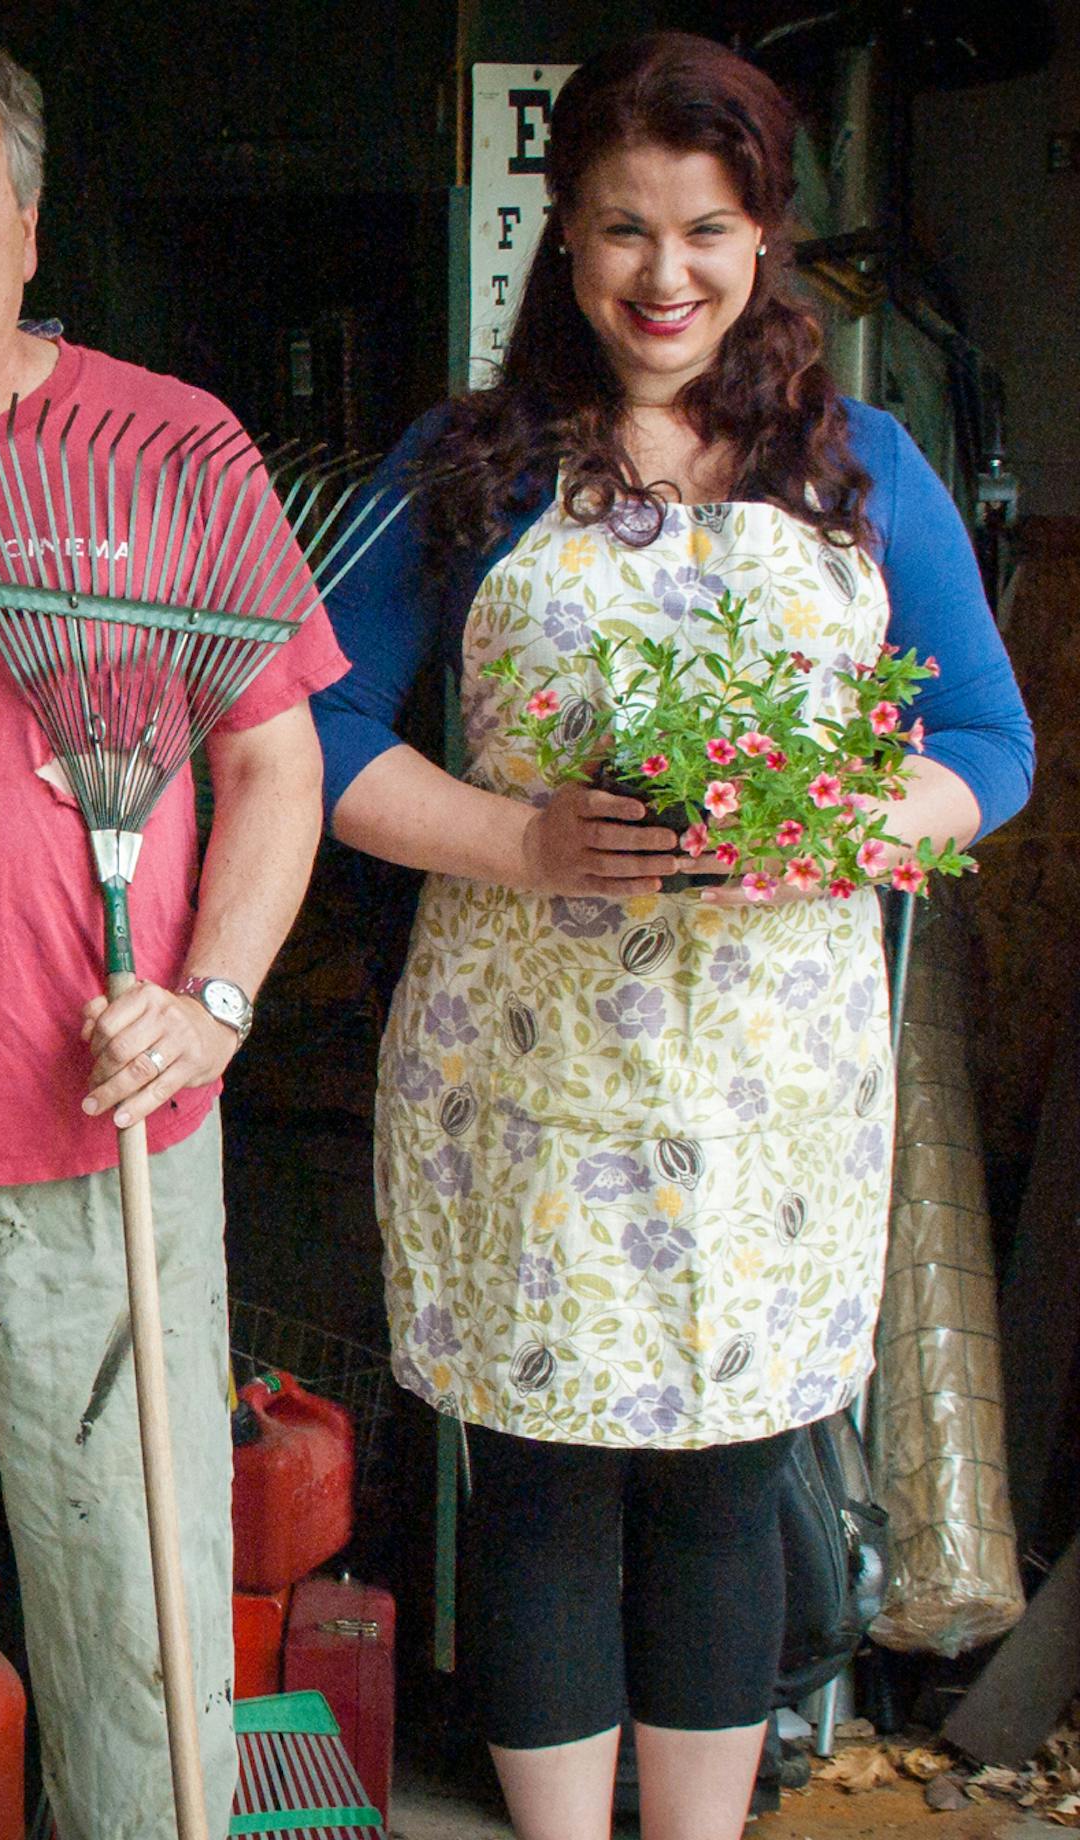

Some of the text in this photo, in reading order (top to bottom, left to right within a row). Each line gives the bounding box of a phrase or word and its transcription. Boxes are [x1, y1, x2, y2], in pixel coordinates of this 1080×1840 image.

[508, 89, 552, 174] E
[497, 207, 520, 249] F
[491, 275, 508, 305] T
[4, 537, 129, 561] CINEMA
